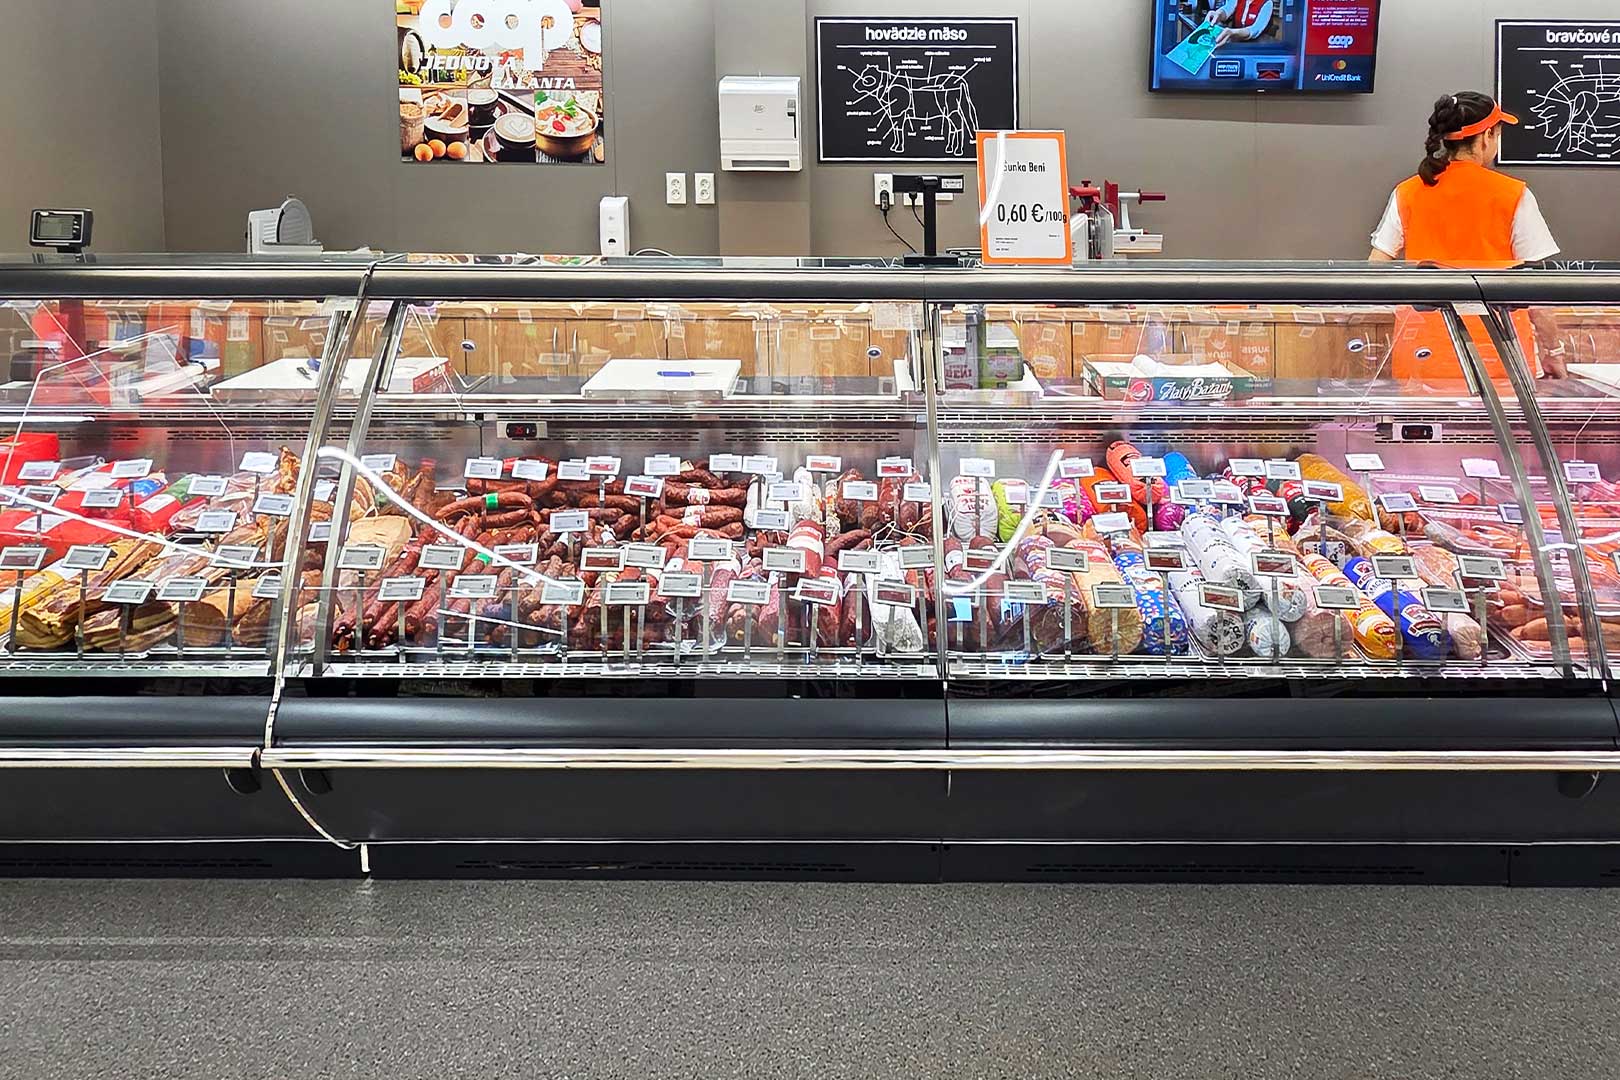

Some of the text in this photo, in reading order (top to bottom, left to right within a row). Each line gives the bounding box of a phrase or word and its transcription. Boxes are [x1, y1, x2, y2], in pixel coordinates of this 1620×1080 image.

[865, 26, 967, 41] hovädzie mäso
[1546, 29, 1610, 43] bravčové
[1327, 35, 1354, 49] coop
[419, 55, 517, 70] JEDNOTA
[1321, 73, 1361, 81] UniCredit Bank
[1028, 161, 1046, 172] Beni
[997, 203, 1027, 225] 0,60
